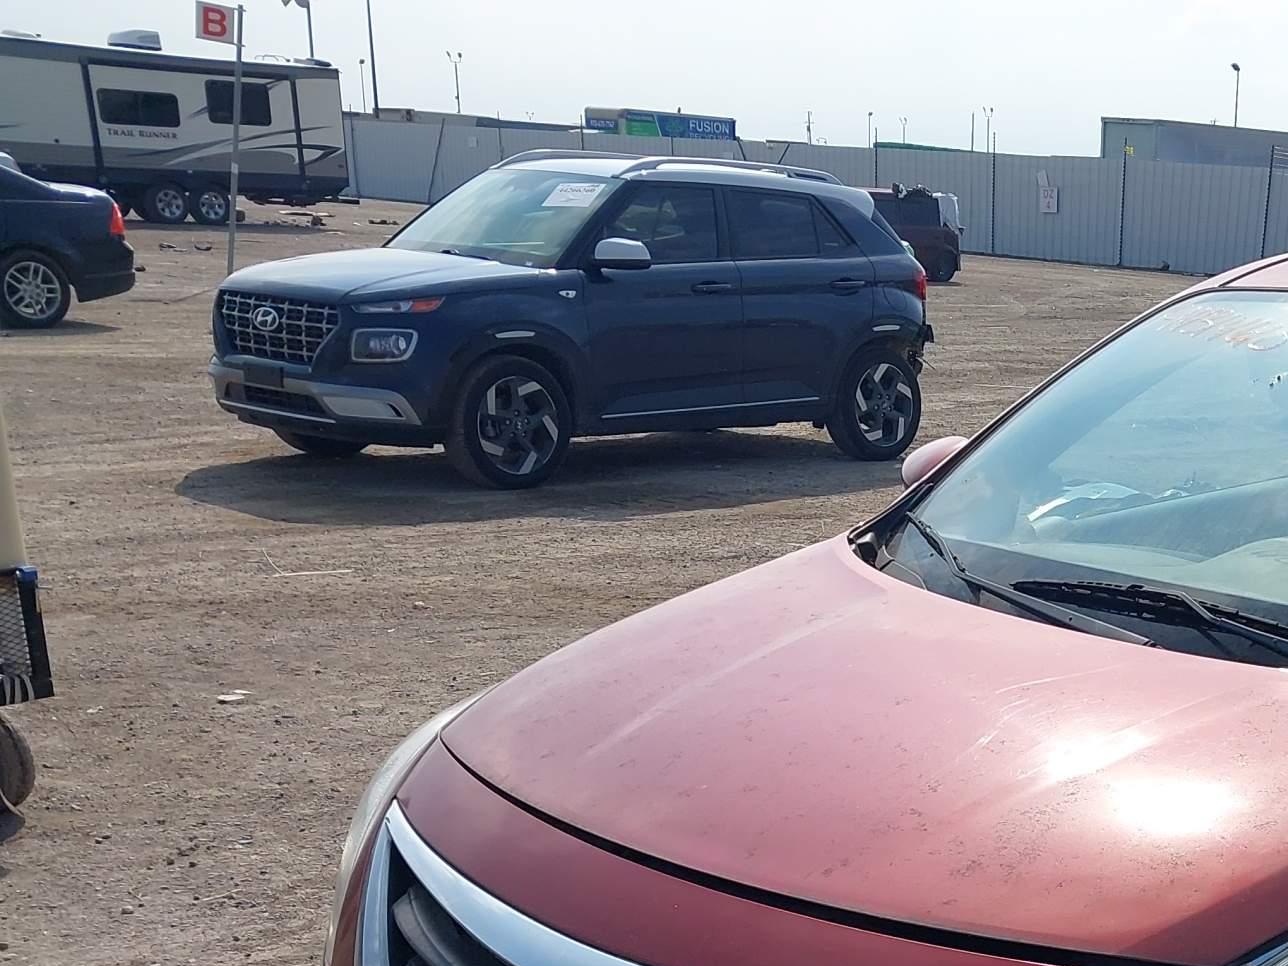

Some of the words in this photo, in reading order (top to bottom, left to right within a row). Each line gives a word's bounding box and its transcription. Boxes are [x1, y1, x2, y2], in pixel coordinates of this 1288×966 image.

[202, 6, 227, 37] B
[107, 128, 135, 137] TRAIL
[139, 130, 177, 139] RUNNER
[689, 120, 730, 134] FUSION
